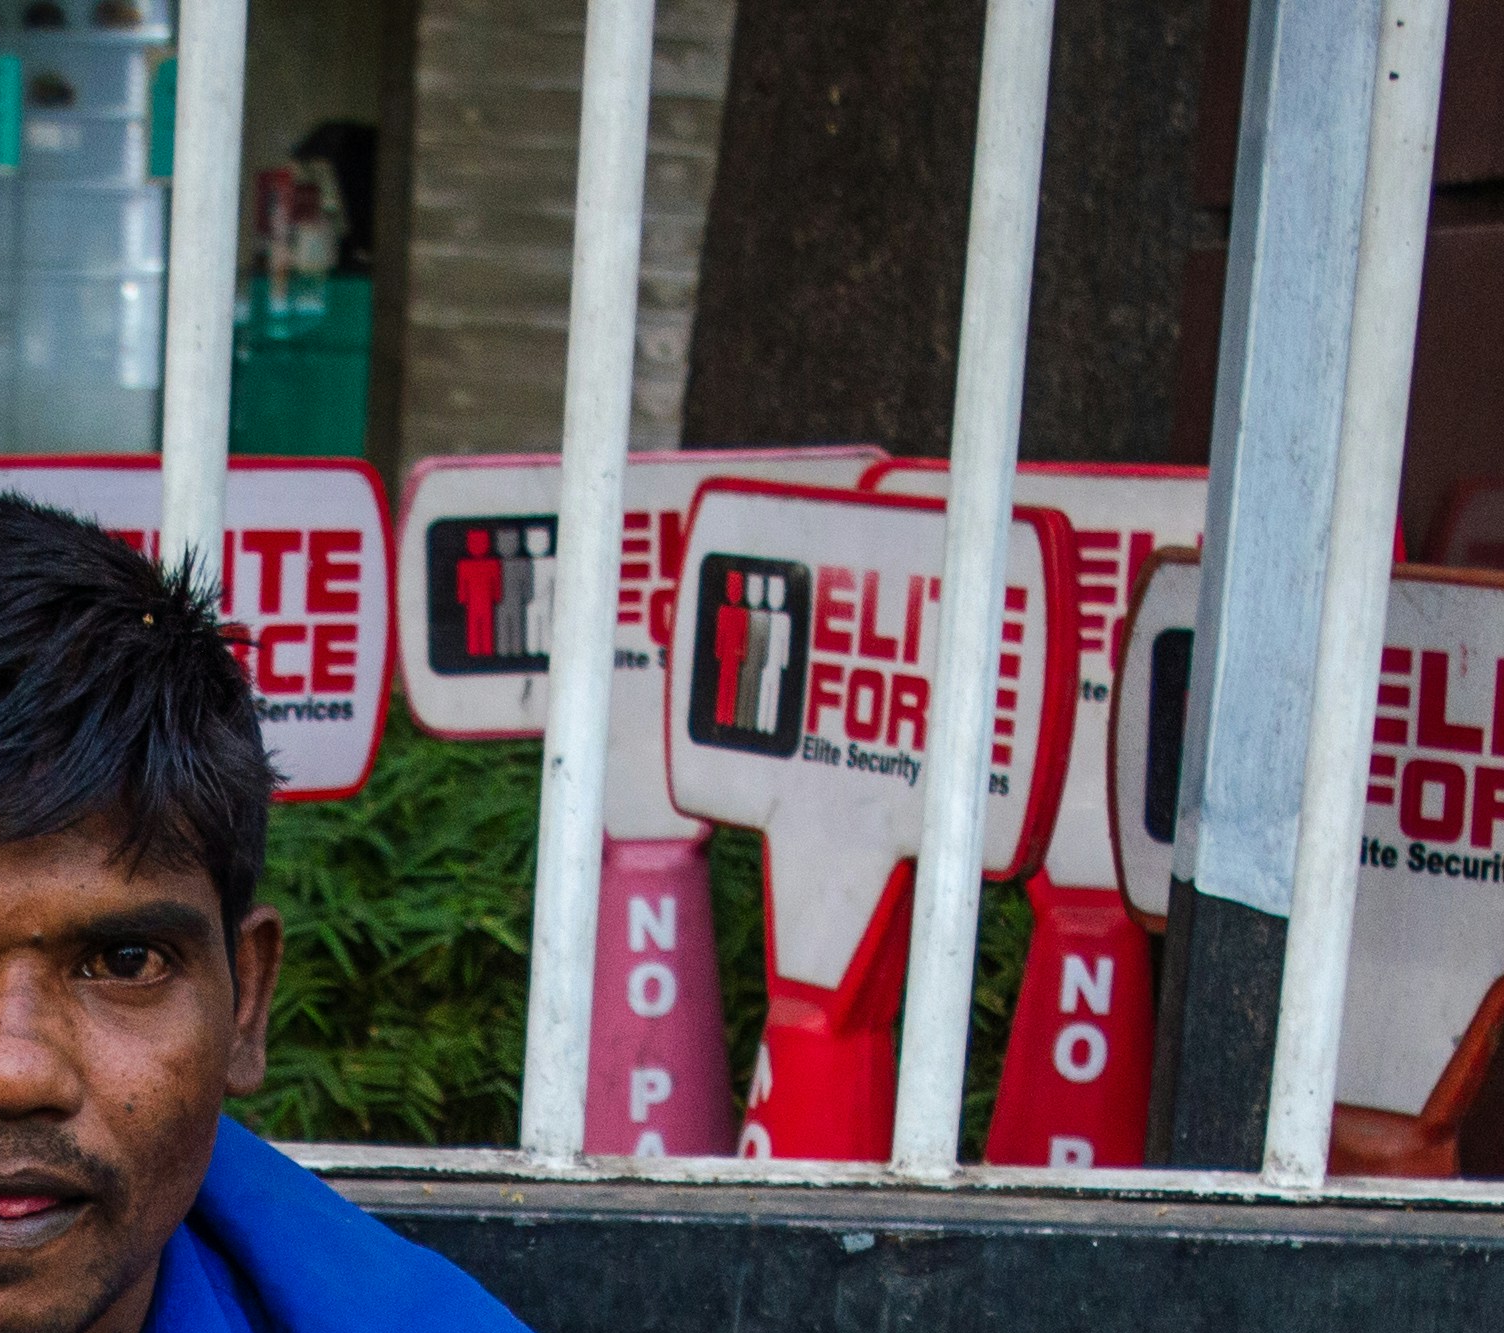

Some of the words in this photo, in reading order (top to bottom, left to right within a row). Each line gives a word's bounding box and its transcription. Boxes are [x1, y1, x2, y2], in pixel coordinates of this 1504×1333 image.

[802, 735, 841, 766] Elite
[846, 742, 922, 787] Security
[1360, 835, 1398, 869] ite
[627, 895, 677, 1019] NO
[1054, 953, 1115, 1084] NO
